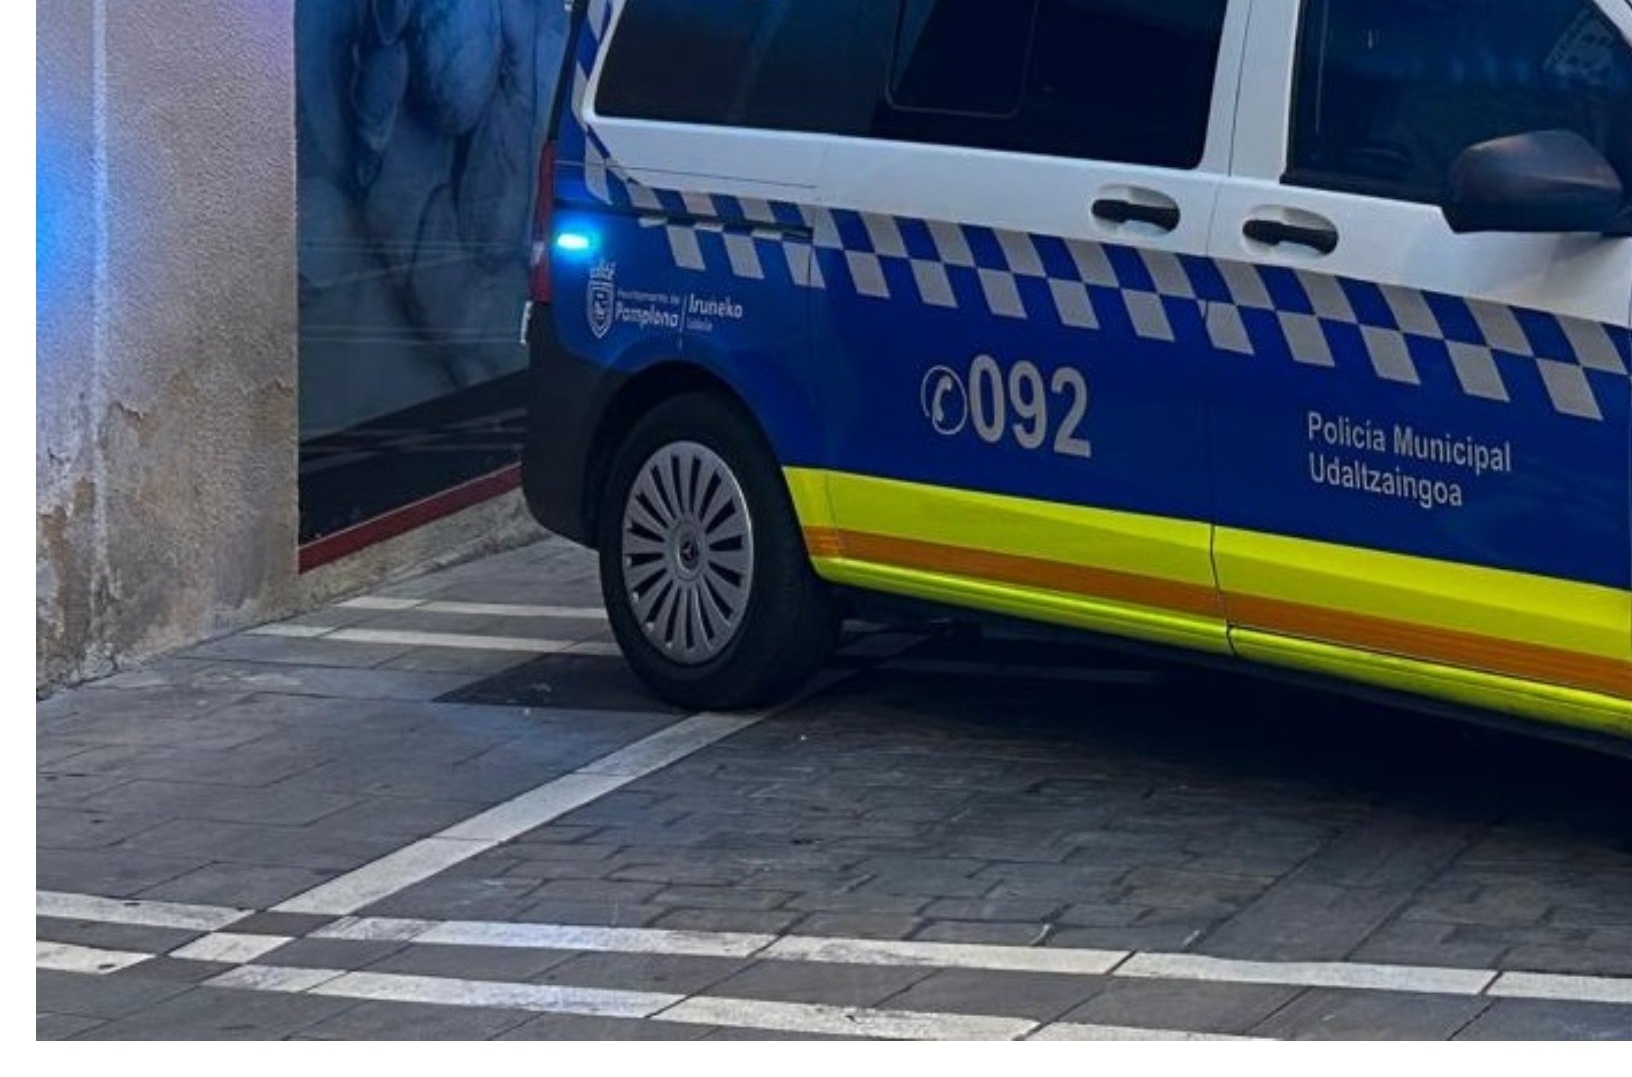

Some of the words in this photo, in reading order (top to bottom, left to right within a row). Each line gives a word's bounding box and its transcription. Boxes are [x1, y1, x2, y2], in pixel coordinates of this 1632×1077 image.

[615, 301, 679, 329] Pamplona
[968, 354, 1092, 458] 092
[1393, 424, 1512, 475] Municipal
[1308, 452, 1463, 510] Udaltzaingoa
